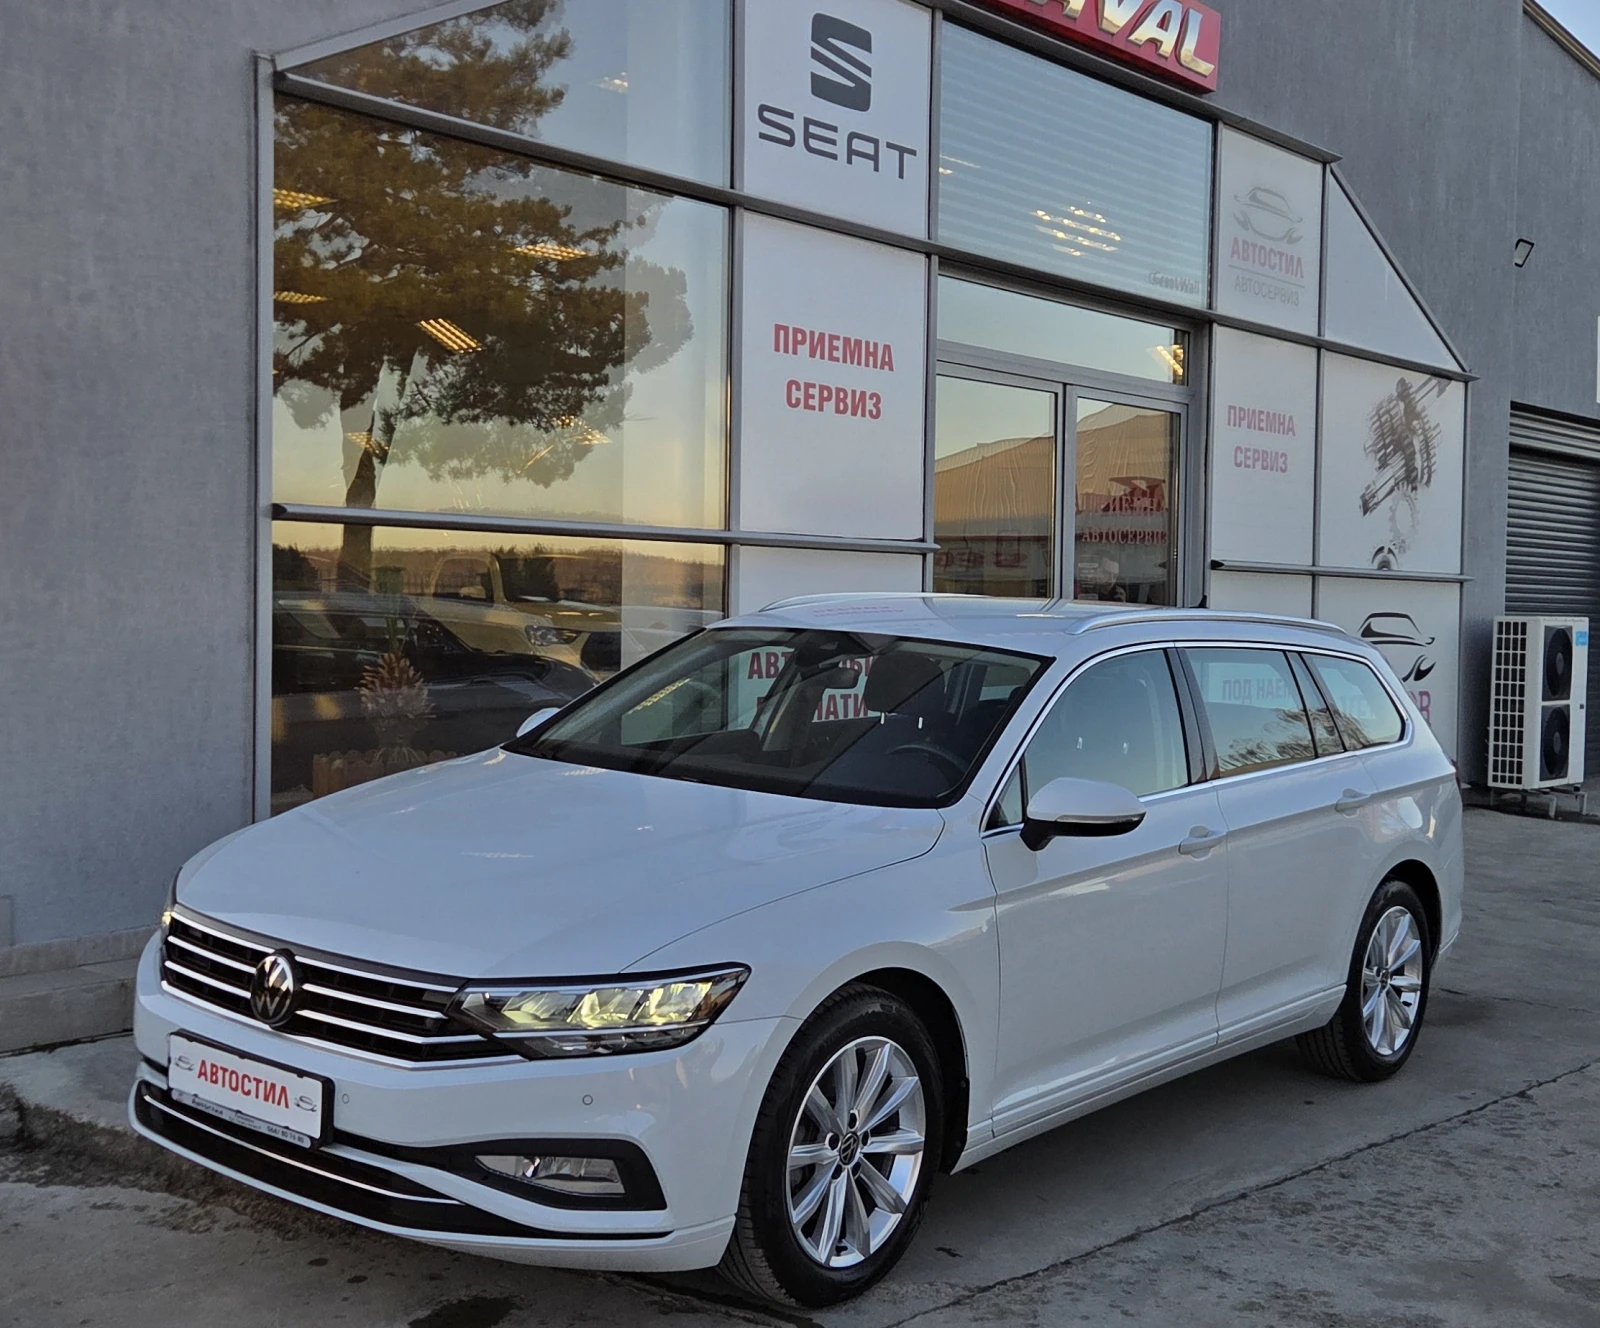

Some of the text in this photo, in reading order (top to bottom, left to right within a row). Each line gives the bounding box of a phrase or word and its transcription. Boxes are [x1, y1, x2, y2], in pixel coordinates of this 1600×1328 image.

[758, 103, 917, 180] SEAT
[1230, 236, 1304, 279] АВТОСТИЛ
[1234, 274, 1299, 307] АВТОСЕРВИЗ
[773, 323, 894, 372] ПРИЕМНА
[786, 379, 882, 420] СЕРВИЗ
[1227, 404, 1296, 437] ПРИЕМНА
[1234, 445, 1288, 474] СЕРВИЗ
[1081, 526, 1169, 546] АВТОСЕРВИЗ
[1222, 679, 1251, 705] ПОД
[197, 1059, 290, 1109] АВТОСТИЛ
